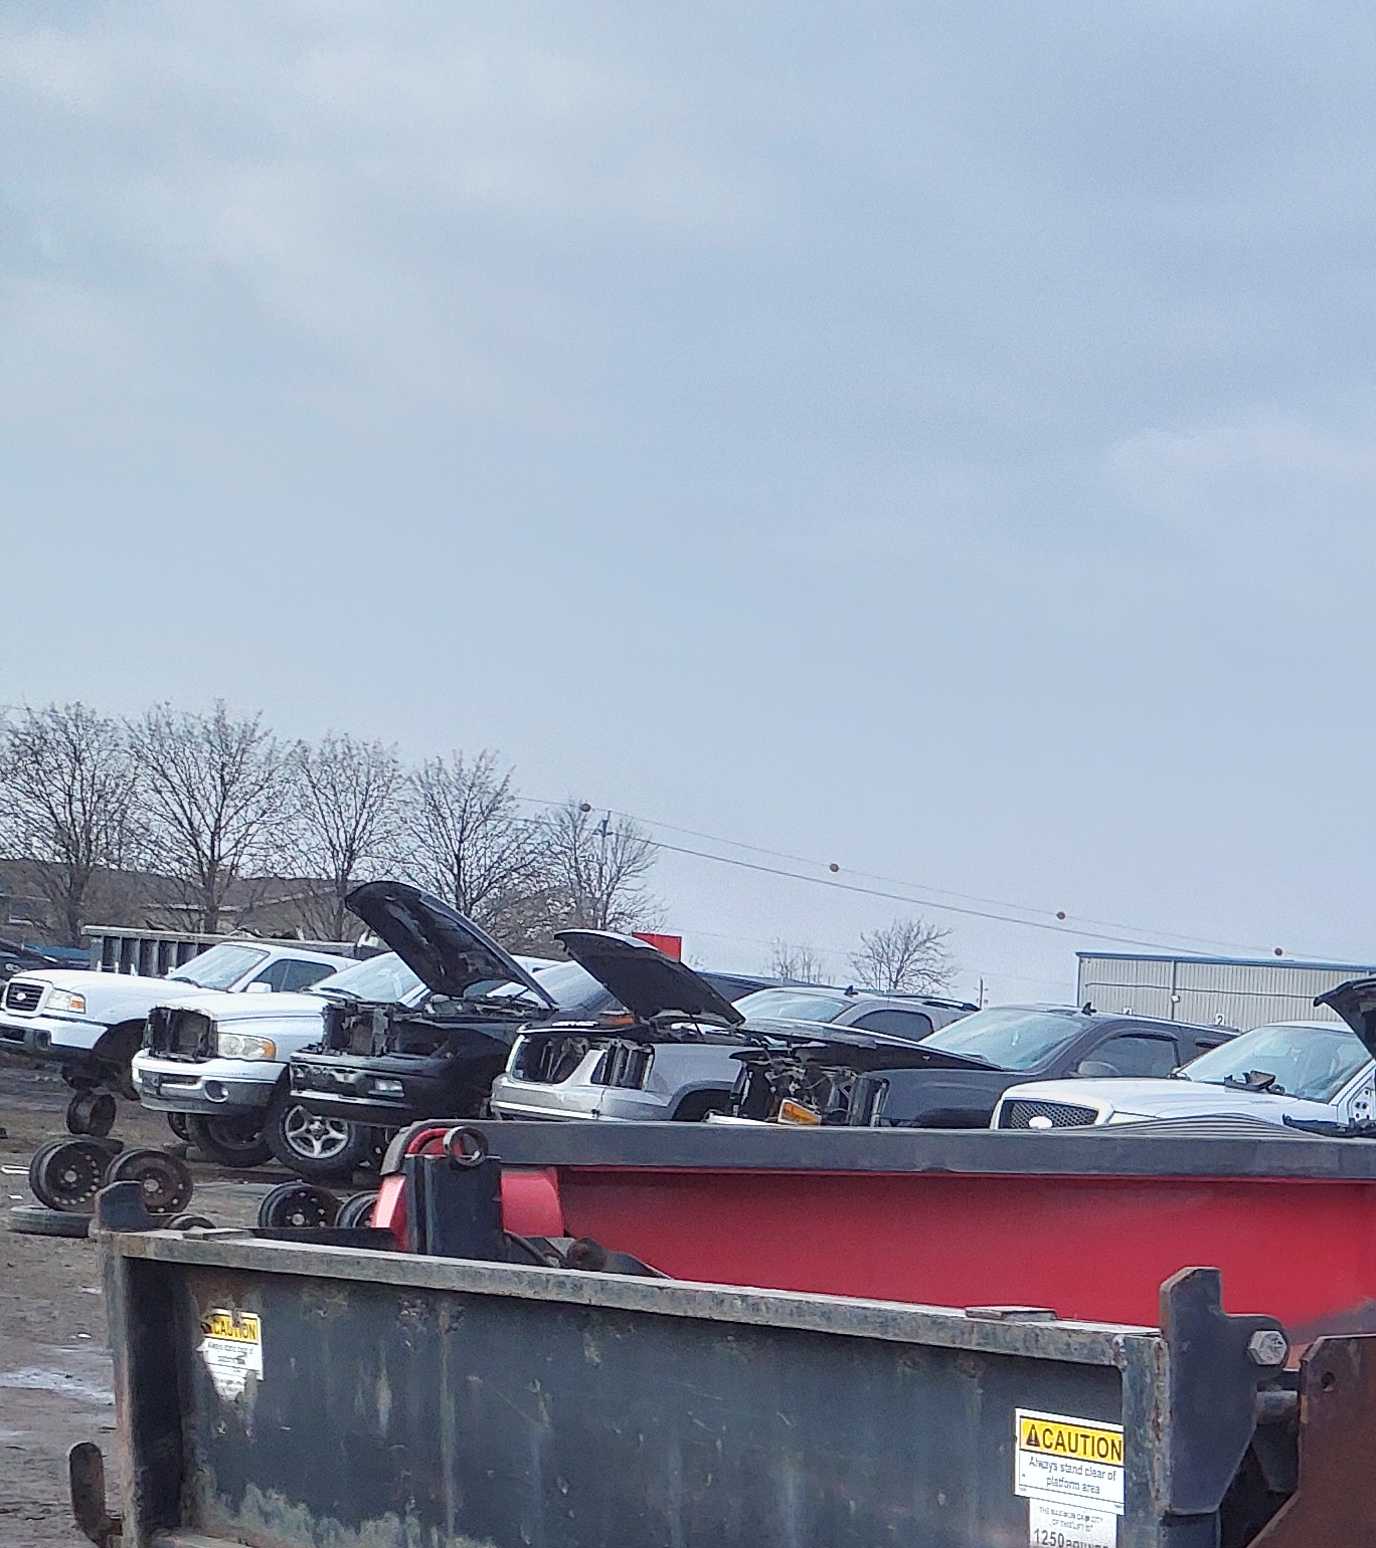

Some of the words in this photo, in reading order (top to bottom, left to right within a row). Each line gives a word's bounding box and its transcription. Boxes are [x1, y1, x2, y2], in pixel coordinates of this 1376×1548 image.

[1042, 1428, 1122, 1462] CAUTION
[1029, 1456, 1058, 1473] Always
[1060, 1463, 1083, 1475] stand
[1107, 1470, 1117, 1481] of
[1046, 1475, 1080, 1490] platform
[1034, 1527, 1065, 1548] 1250
